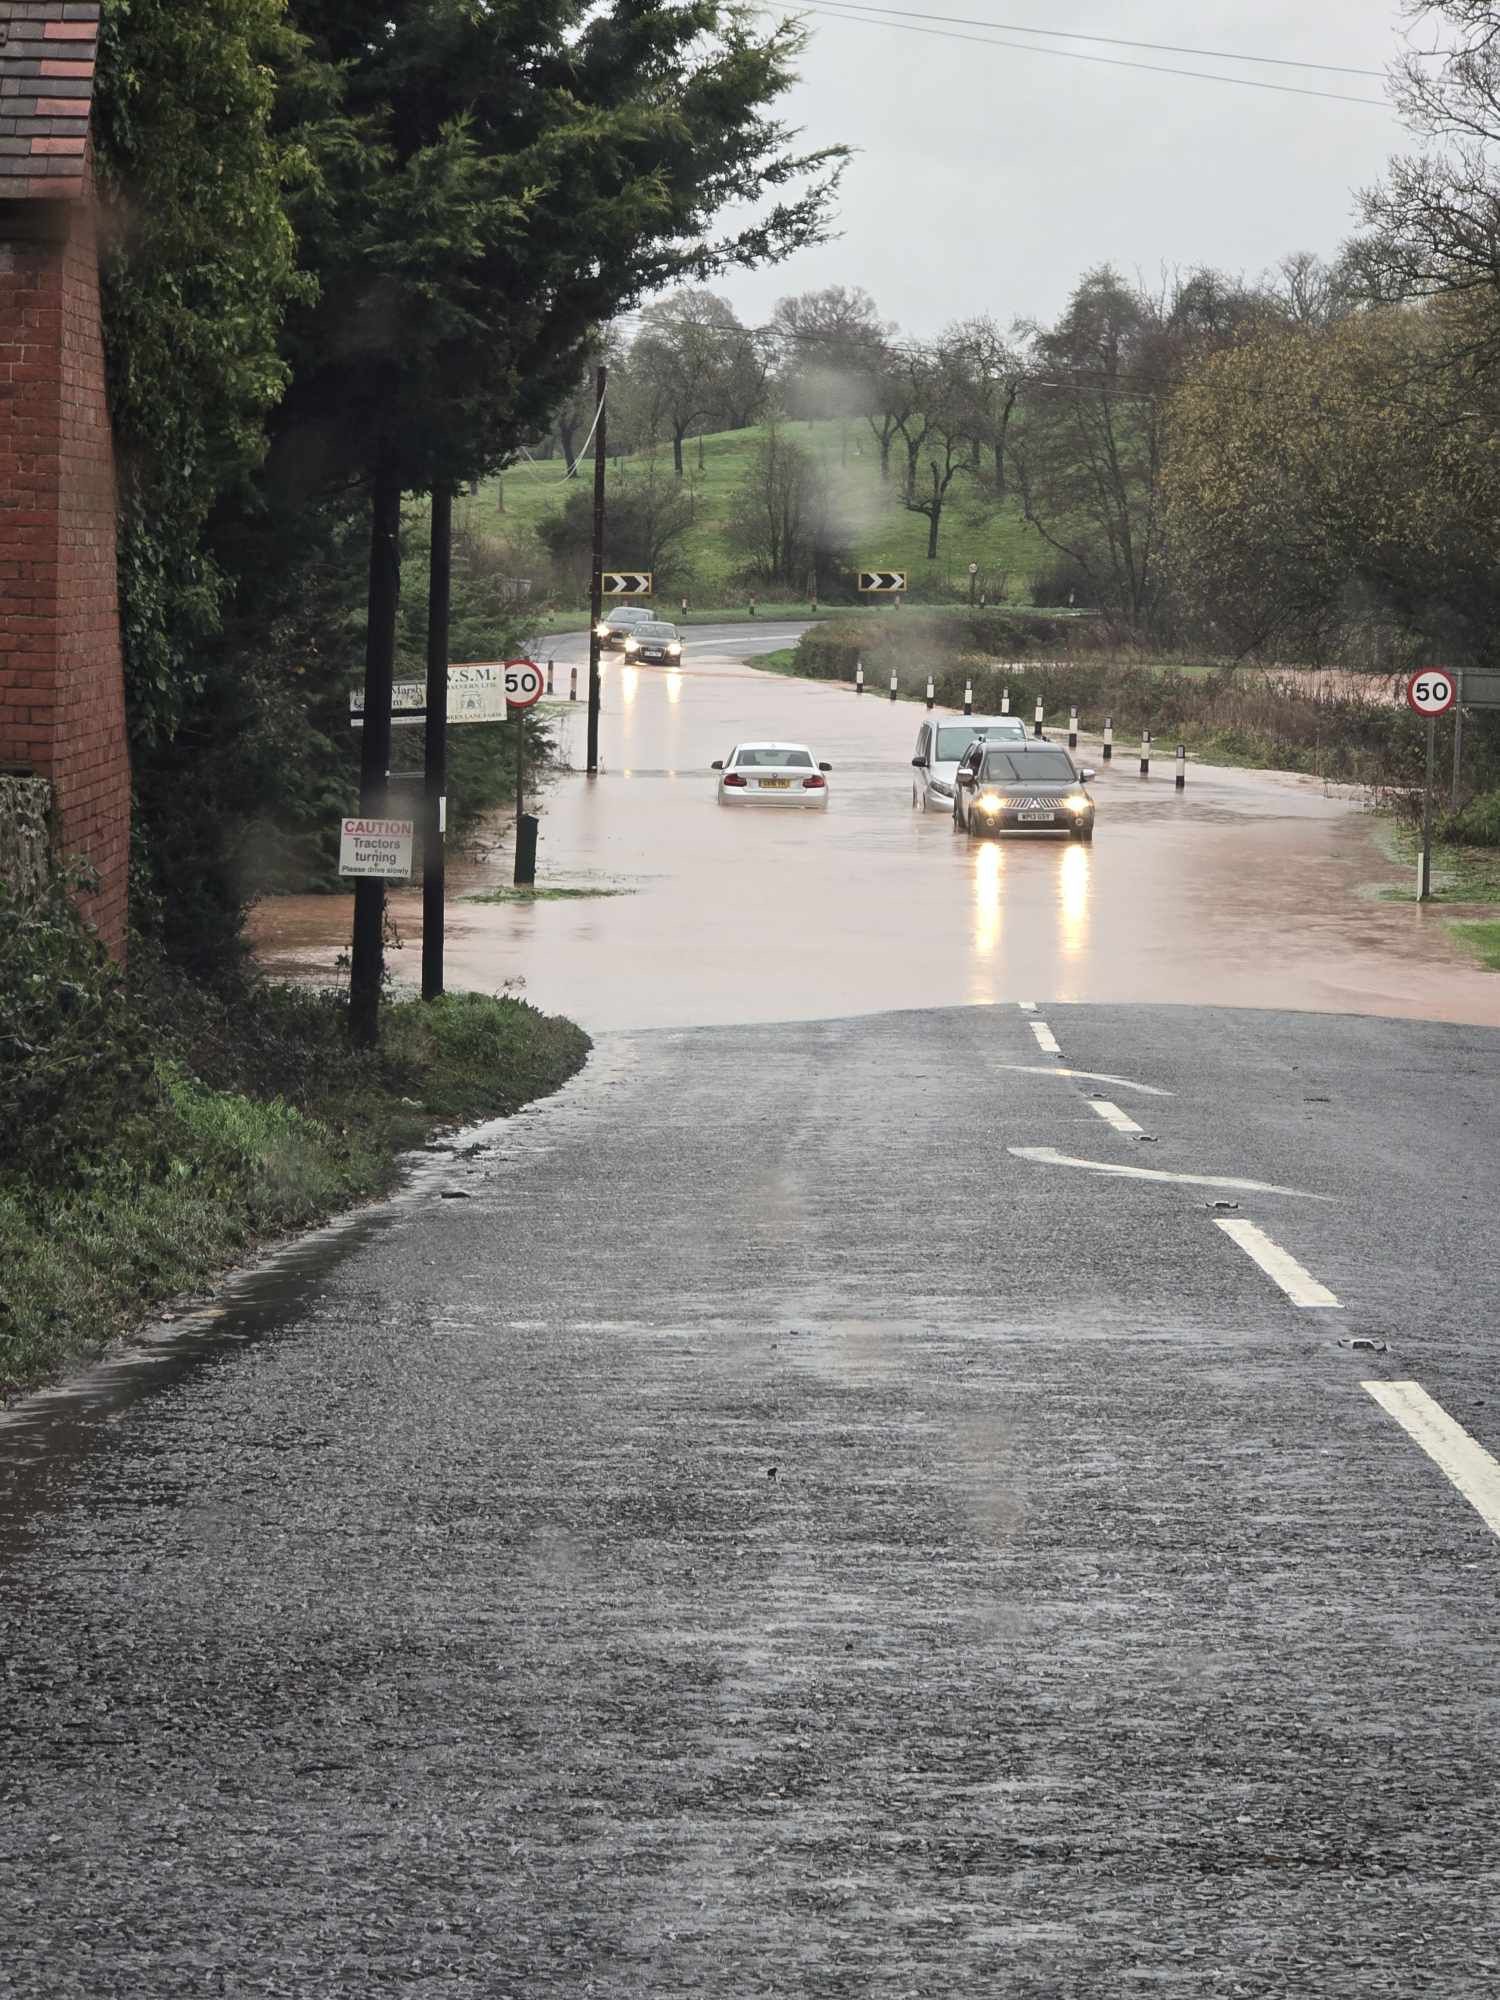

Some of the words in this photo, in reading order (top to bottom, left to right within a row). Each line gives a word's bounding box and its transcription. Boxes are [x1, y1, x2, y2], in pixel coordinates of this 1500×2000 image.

[505, 673, 537, 692] 50
[1416, 682, 1448, 701] 50
[344, 821, 411, 834] CAUTION
[353, 837, 400, 849] Tractors
[355, 852, 397, 865] turning
[342, 865, 365, 873] Please
[368, 865, 385, 873] drive
[387, 866, 408, 875] slowly
